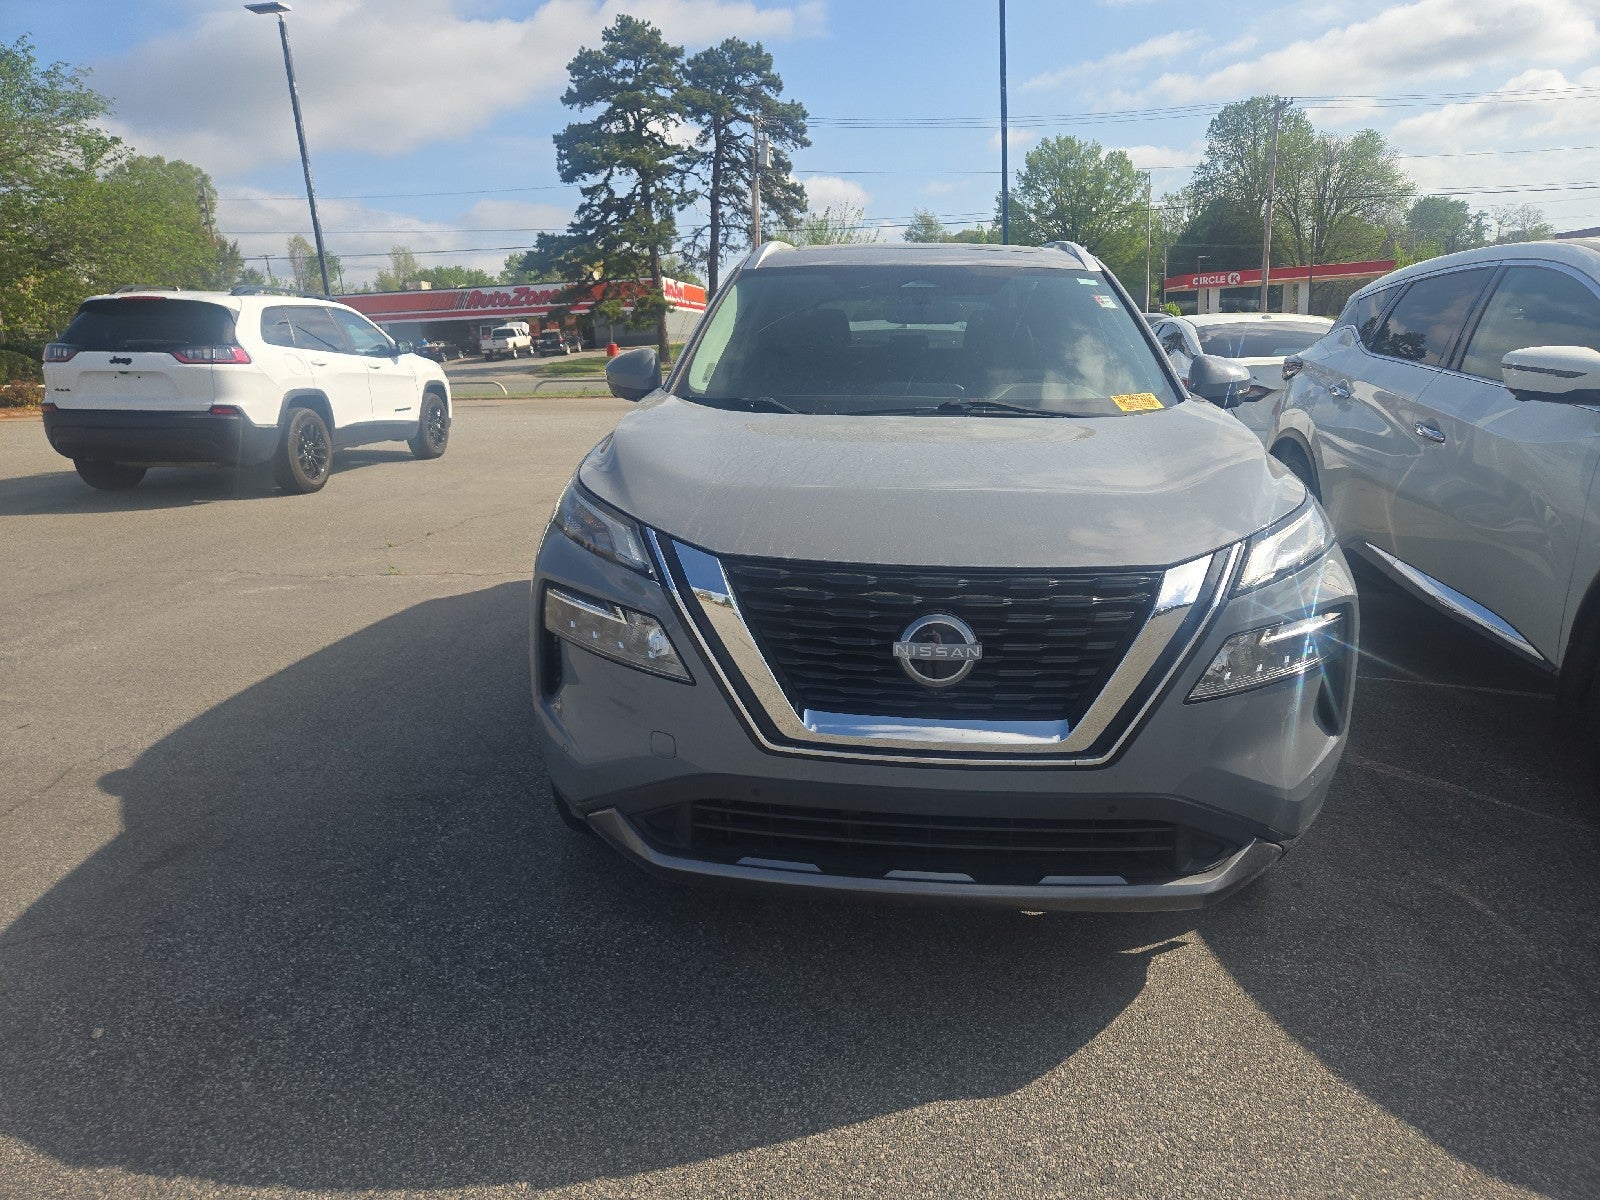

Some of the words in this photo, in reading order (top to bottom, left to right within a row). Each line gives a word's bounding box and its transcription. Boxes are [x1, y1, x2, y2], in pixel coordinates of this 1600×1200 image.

[1192, 275, 1226, 285] CIRCLE
[1229, 272, 1240, 285] K
[109, 356, 132, 365] Jeep
[895, 644, 980, 658] NISSAN
